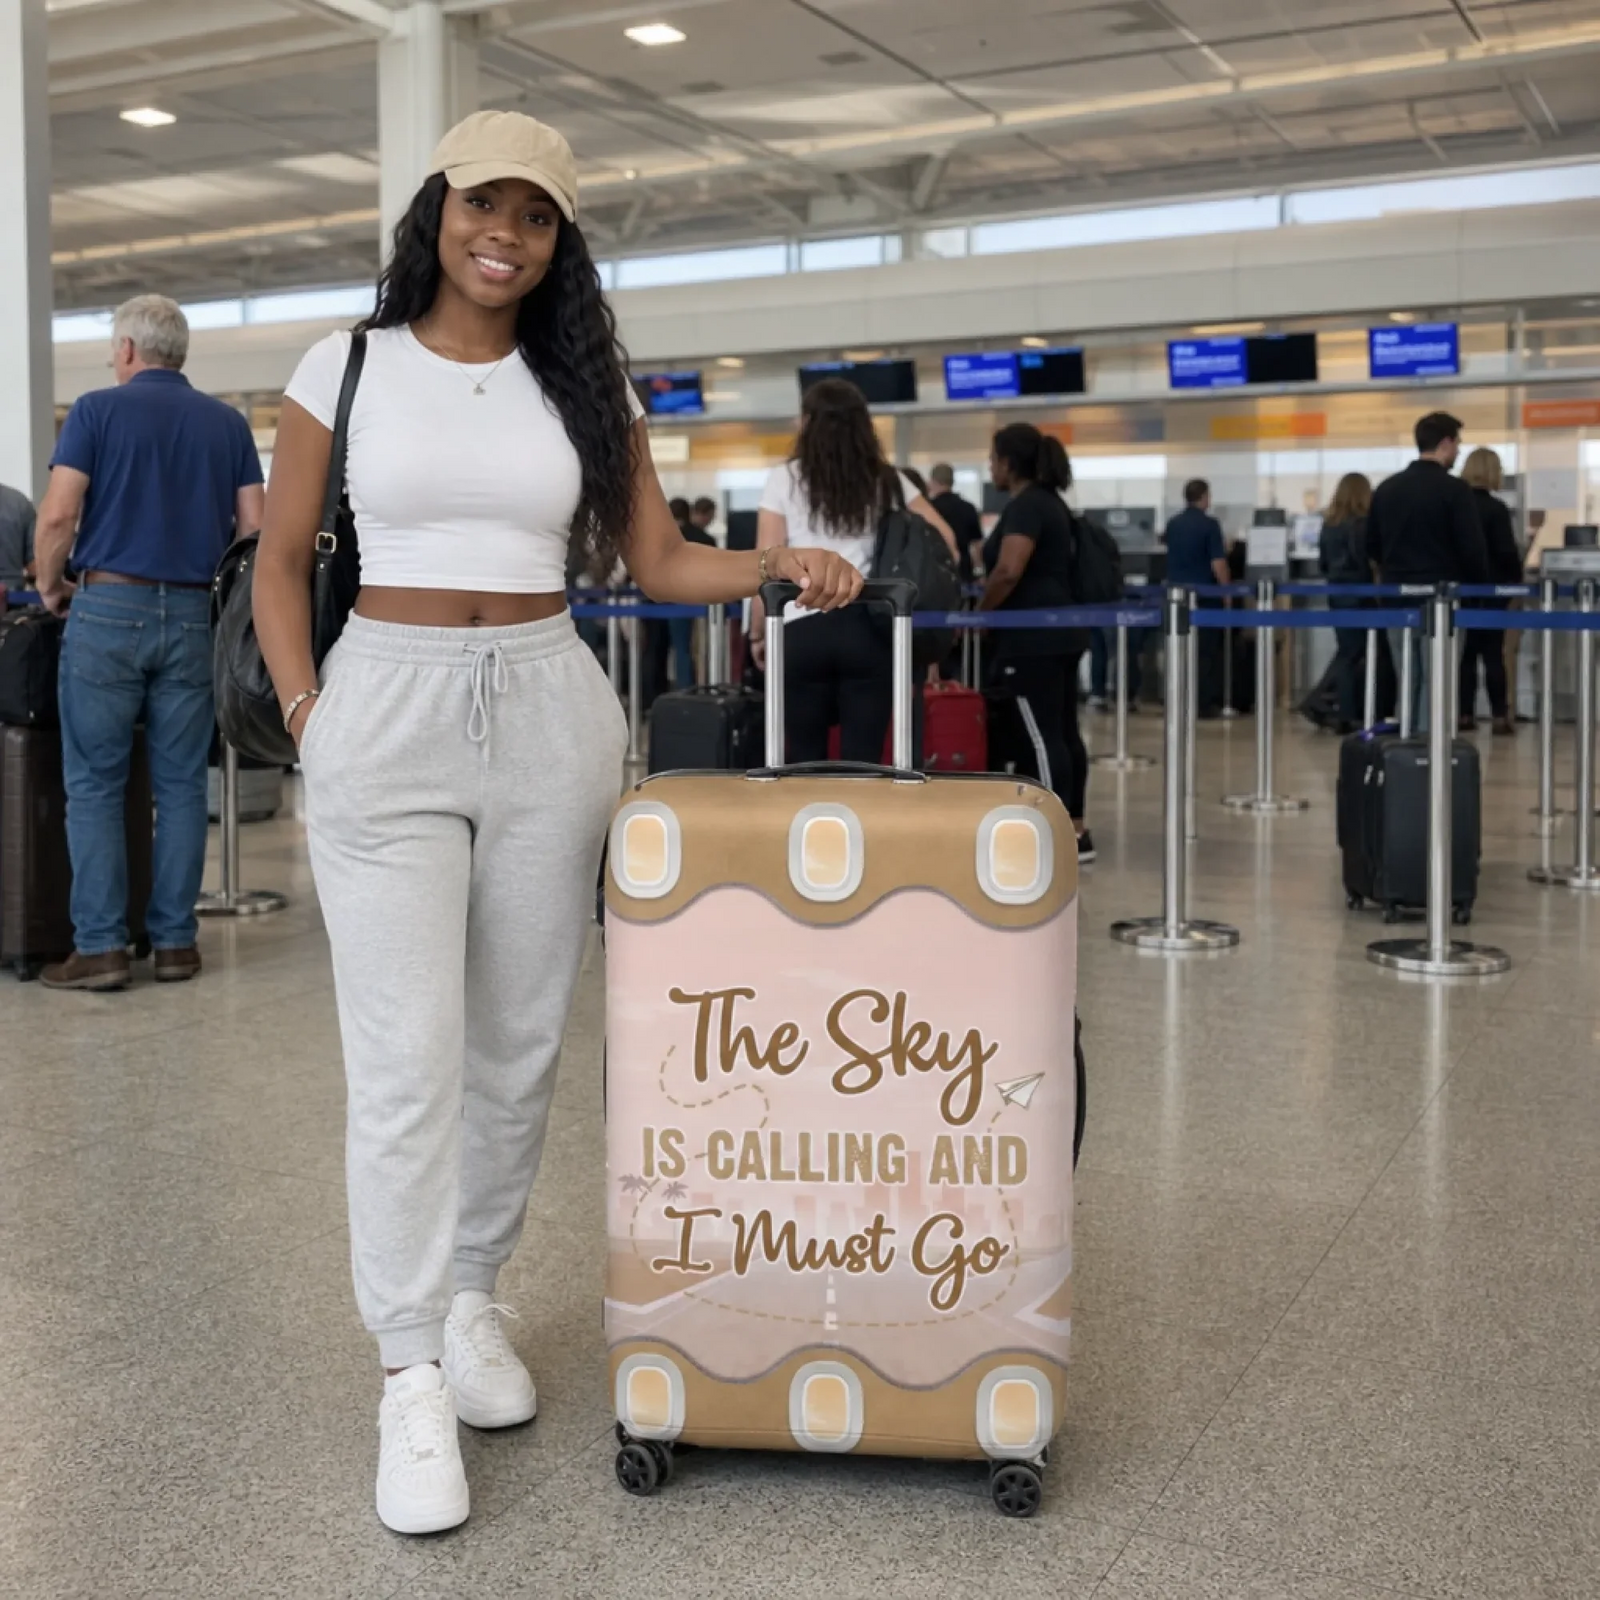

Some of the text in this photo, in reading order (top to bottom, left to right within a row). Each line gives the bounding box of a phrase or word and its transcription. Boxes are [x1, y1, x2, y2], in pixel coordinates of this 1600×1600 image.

[668, 987, 999, 1126] The Sky
[642, 1127, 1028, 1185] IS CALLING AND
[652, 1206, 1010, 1311] I Must Go
